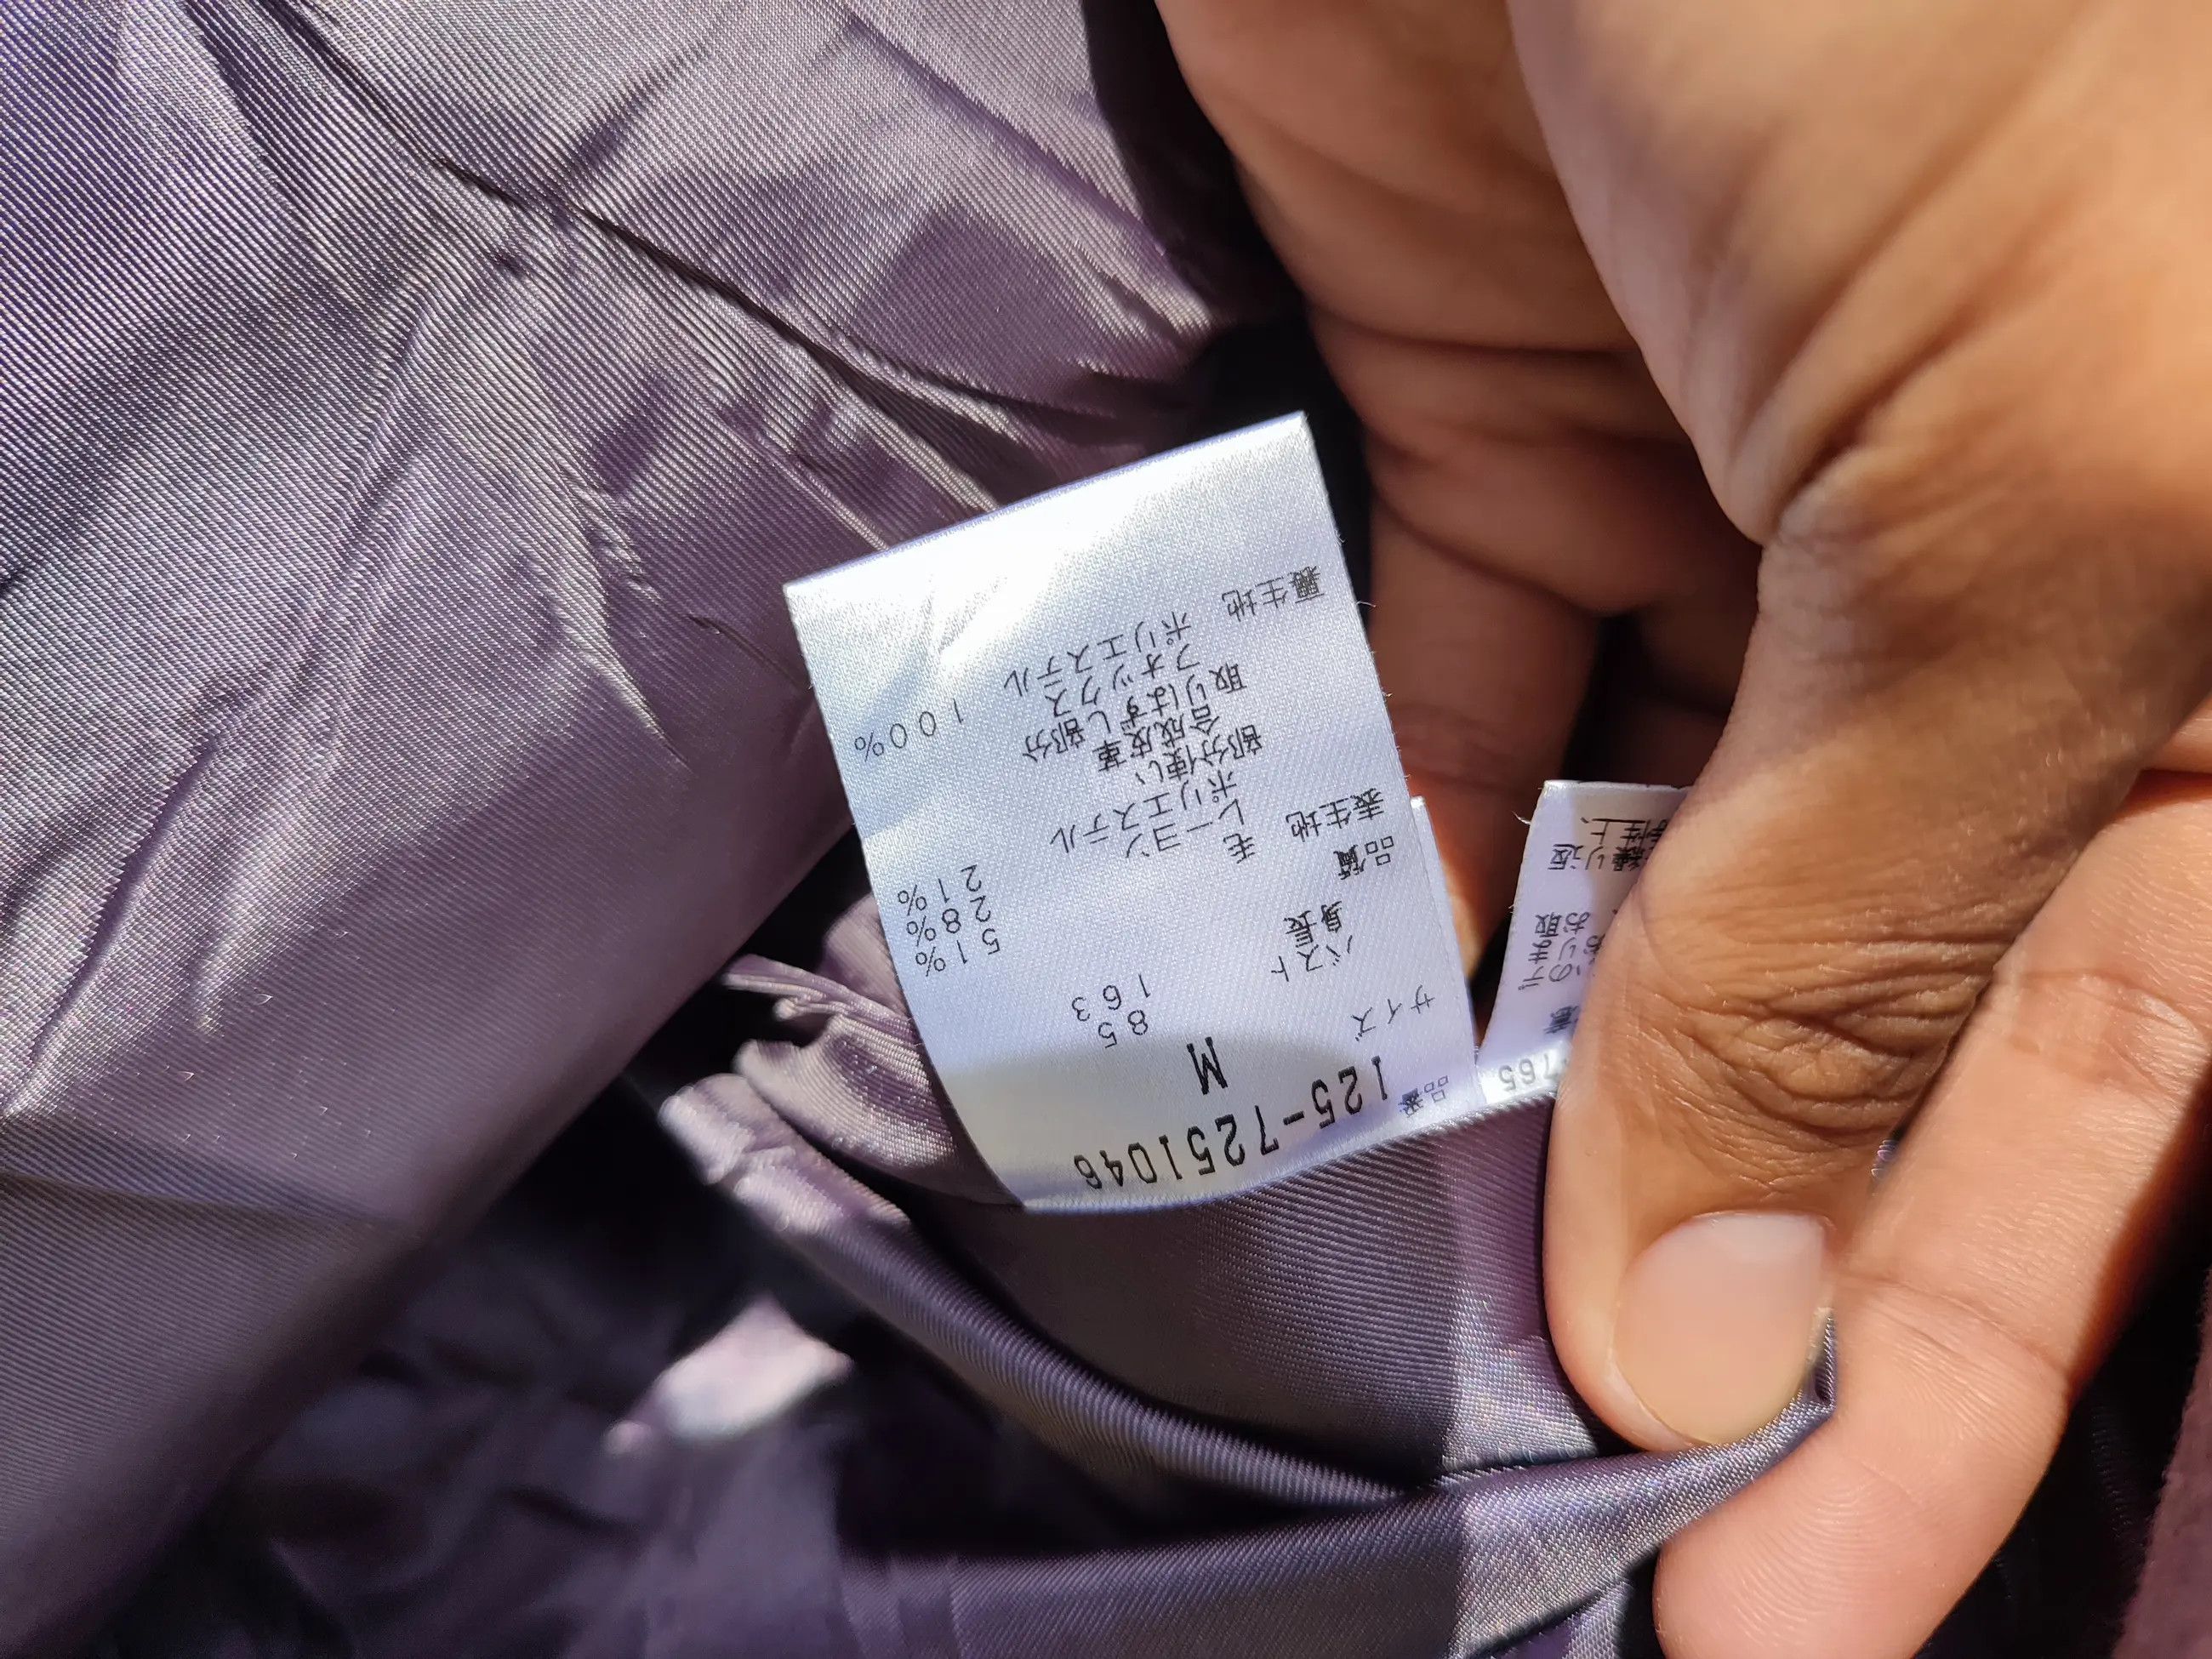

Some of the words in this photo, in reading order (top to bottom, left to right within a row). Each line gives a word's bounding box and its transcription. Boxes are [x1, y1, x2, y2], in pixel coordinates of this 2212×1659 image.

[1002, 610, 1192, 698] ポリエステル
[1042, 641, 1200, 719] フォックス
[1021, 661, 1248, 764] 取りはずし部分
[1091, 702, 1221, 772] 合成皮革
[1133, 723, 1263, 785] 部分使い
[1048, 768, 1240, 854] ポリエステル
[1123, 796, 1246, 859] レーヨン
[1284, 786, 1385, 843] 表生地
[1221, 831, 1256, 864] 毛
[1331, 834, 1395, 881] 品質
[1546, 842, 1655, 872] 繰り返
[1281, 899, 1343, 949] 身長
[1269, 933, 1354, 983] バスト
[1349, 983, 1435, 1042] サイズ
[1184, 1035, 1229, 1096] M
[1072, 1054, 1388, 1190] 125-7251046
